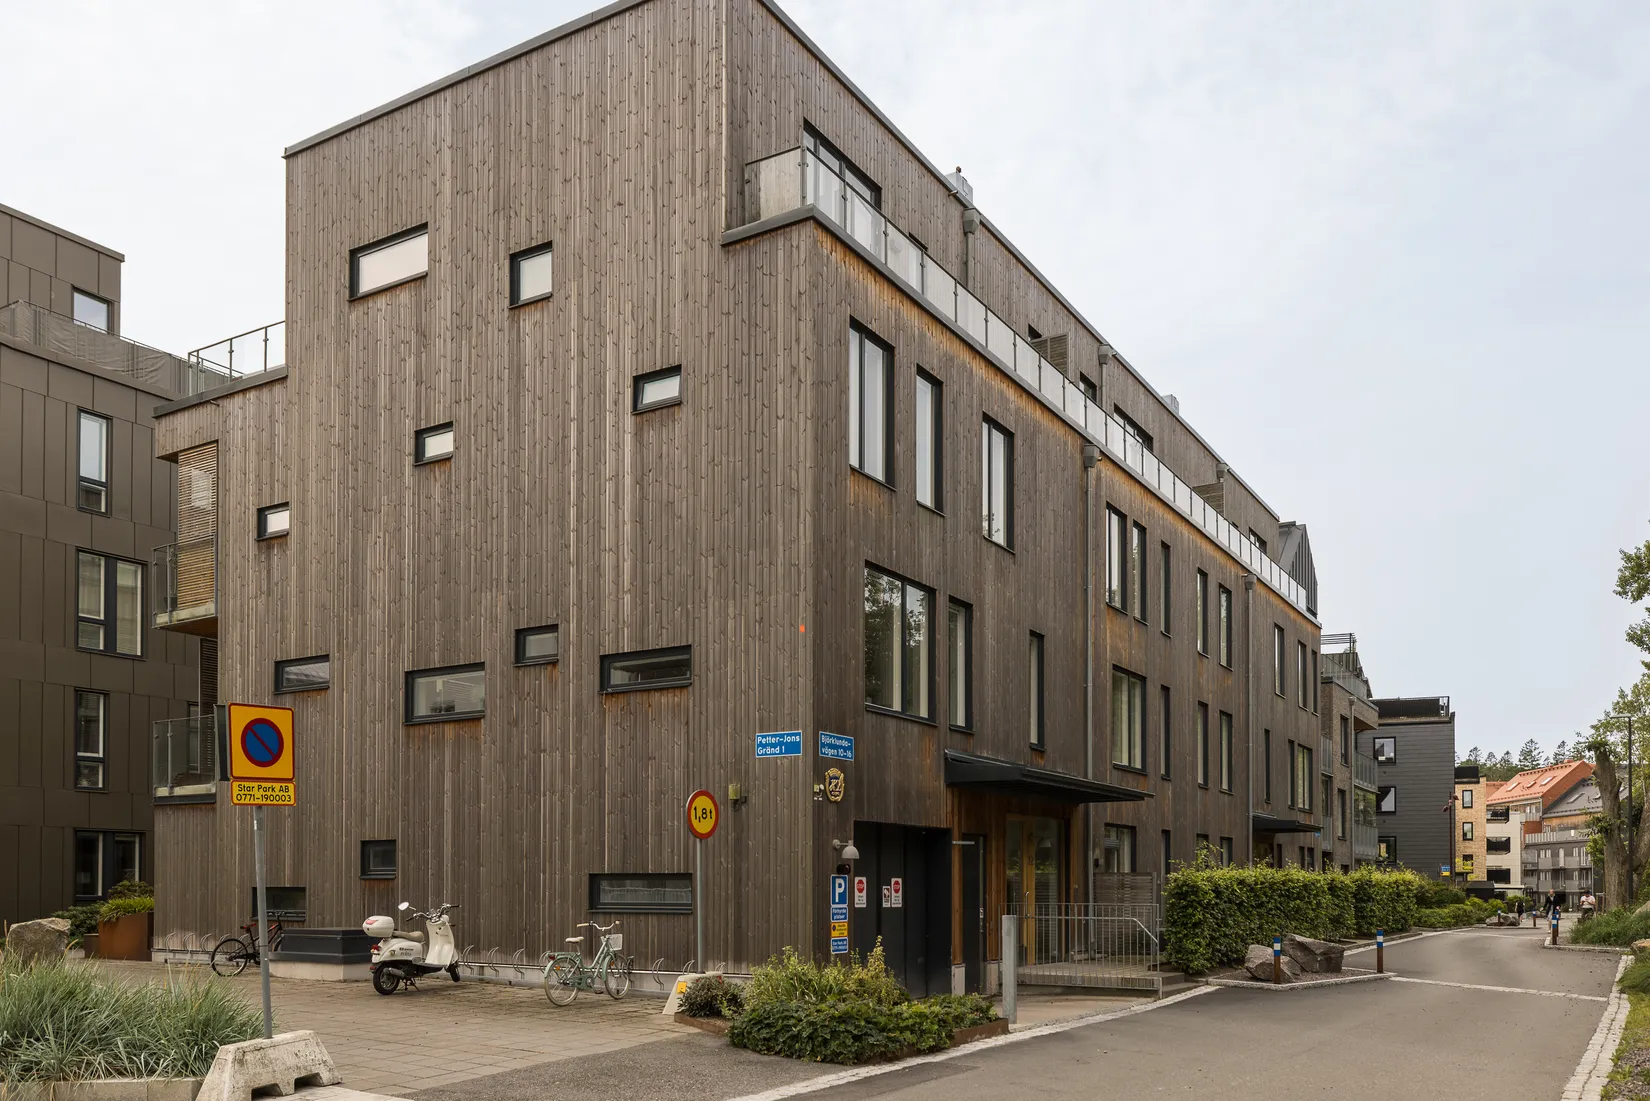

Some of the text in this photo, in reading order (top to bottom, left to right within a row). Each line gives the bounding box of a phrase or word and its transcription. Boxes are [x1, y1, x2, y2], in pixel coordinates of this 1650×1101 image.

[757, 735, 801, 744] Petter-Jons
[821, 735, 851, 747] Björklunda-
[757, 746, 780, 755] Gränd
[821, 747, 852, 758] vägen 10-16
[237, 784, 290, 793] Star Park AB
[236, 794, 292, 802] 0771-190003
[835, 878, 845, 903] P
